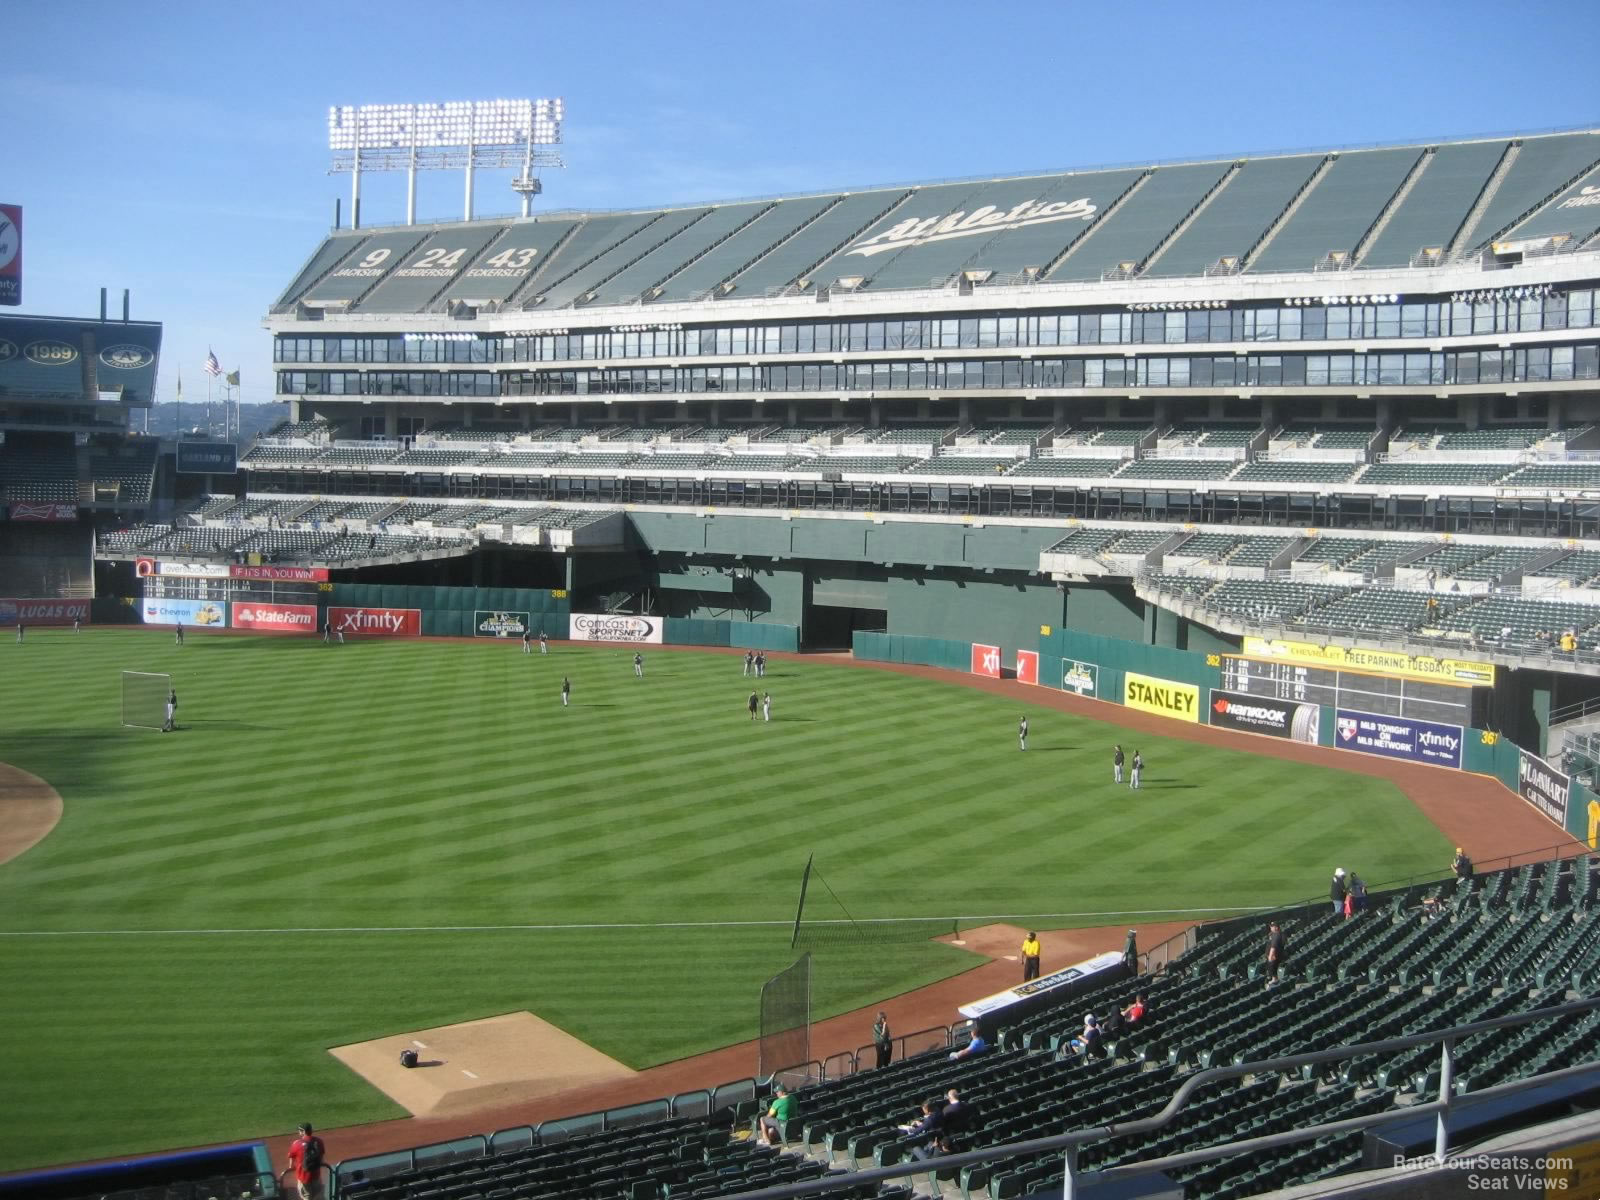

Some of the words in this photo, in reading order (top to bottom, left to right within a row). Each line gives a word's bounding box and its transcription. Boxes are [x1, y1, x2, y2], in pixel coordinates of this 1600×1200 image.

[853, 198, 1097, 249] Athletics
[359, 248, 391, 268] 9
[412, 248, 467, 268] 24
[486, 248, 538, 268] 43
[333, 268, 385, 277] JACKSON
[394, 268, 458, 277] HENDERSON
[466, 268, 531, 277] ECKERSLEY
[31, 345, 73, 360] 1989
[275, 569, 293, 578] YOU
[295, 570, 314, 579] WIN!
[19, 605, 64, 618] LUCAS
[160, 607, 191, 617] Chevron
[344, 610, 404, 633] xfinity
[588, 628, 644, 637] SPORTSNET
[1344, 651, 1366, 665] FREE
[1367, 655, 1405, 669] PARKING
[1408, 658, 1452, 675] TUESDAYS
[1128, 681, 1194, 713] STANLEY
[1235, 714, 1258, 726] driving
[1258, 718, 1286, 728] emotion
[1360, 720, 1376, 731] MLB
[1377, 723, 1410, 736] TONIGHT
[1357, 735, 1373, 746] MLB
[1374, 739, 1412, 752] NETWORK
[1379, 732, 1392, 741] ON
[1418, 731, 1459, 751] xfinity
